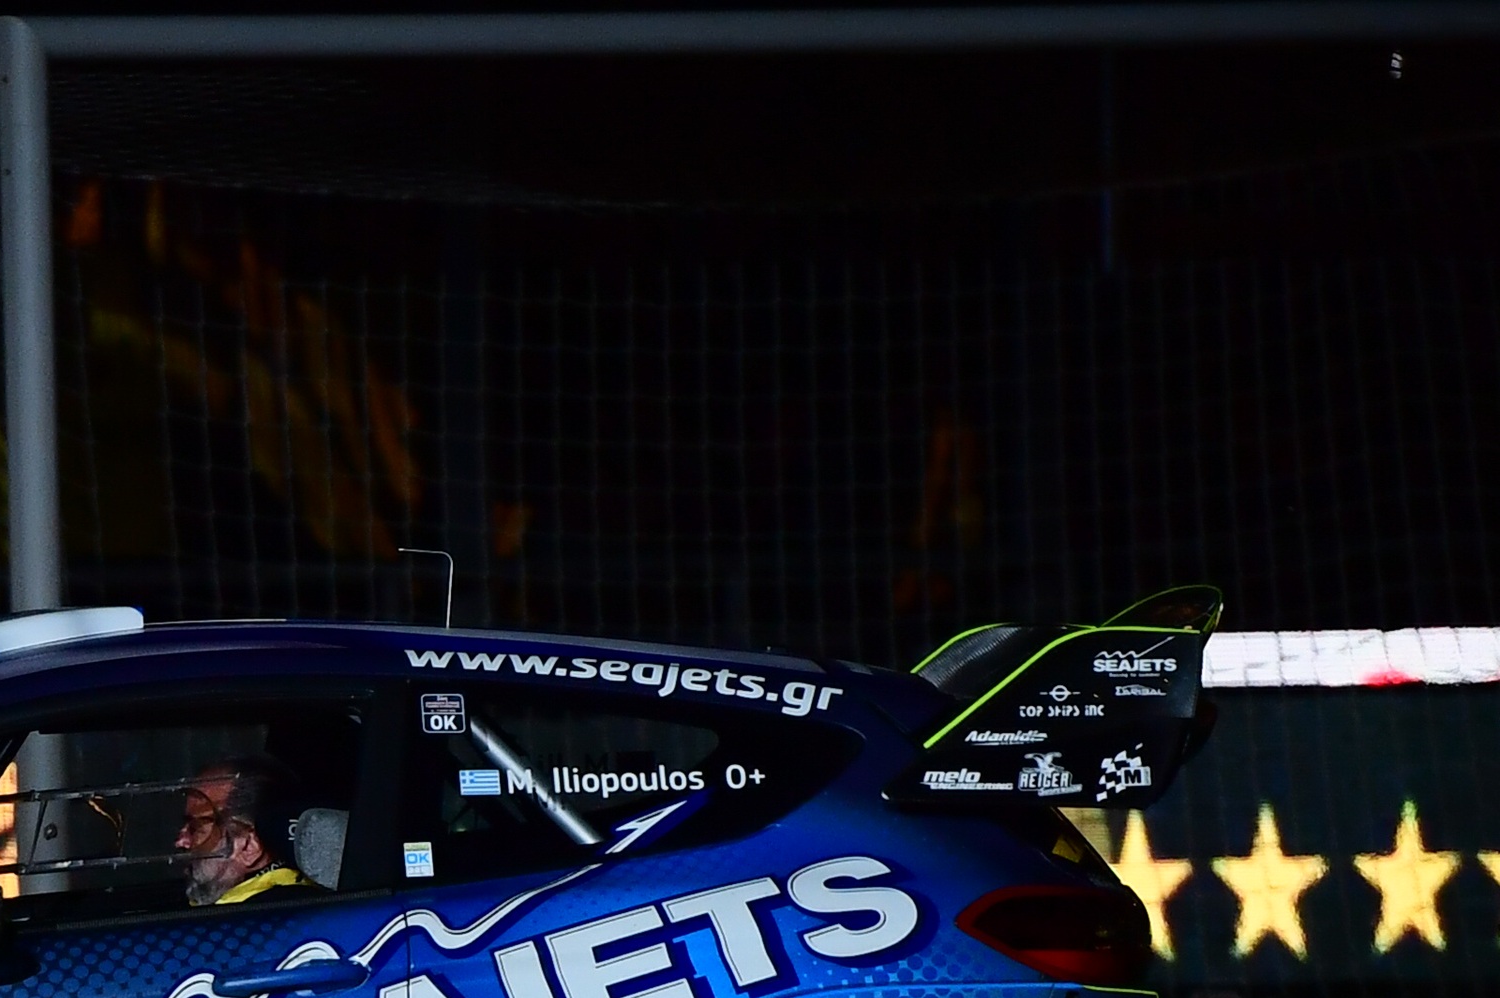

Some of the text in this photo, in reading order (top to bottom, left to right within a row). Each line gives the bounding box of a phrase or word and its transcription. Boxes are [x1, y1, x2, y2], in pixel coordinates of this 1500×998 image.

[1092, 657, 1178, 673] SEAJETS
[404, 648, 844, 717] www.seajets.gr
[430, 714, 458, 731] OK
[552, 763, 706, 799] Iliopoulos
[406, 852, 430, 865] OK
